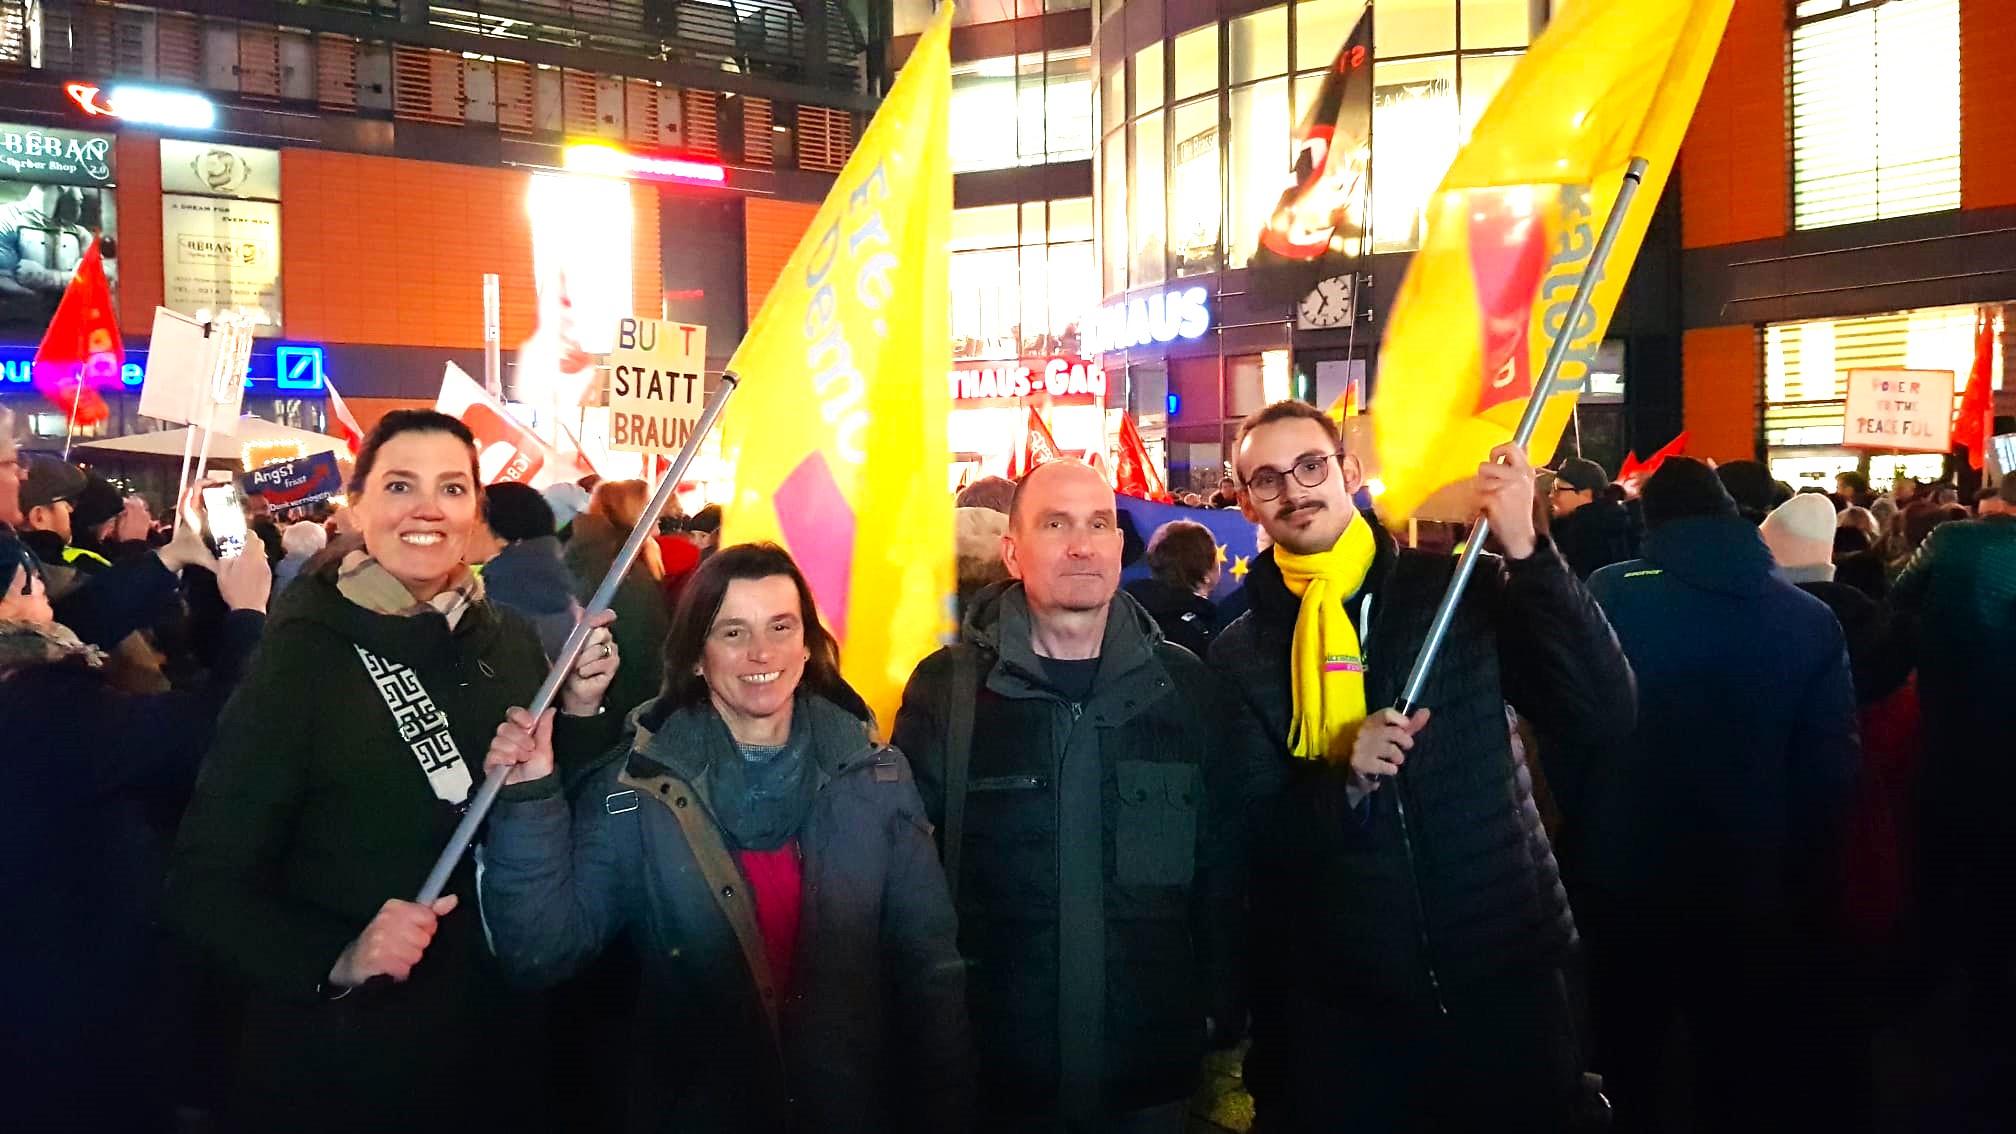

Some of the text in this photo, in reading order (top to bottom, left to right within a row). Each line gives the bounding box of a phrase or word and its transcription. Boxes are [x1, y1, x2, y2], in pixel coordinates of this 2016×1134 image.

[49, 160, 77, 173] Shop
[850, 156, 898, 341] Fre
[619, 318, 697, 356] BUT
[1086, 287, 1210, 356] HAUS
[615, 365, 698, 404] STATT
[1872, 379, 1921, 394] POER
[614, 412, 695, 448] BRAUN
[254, 463, 294, 485] Angst
